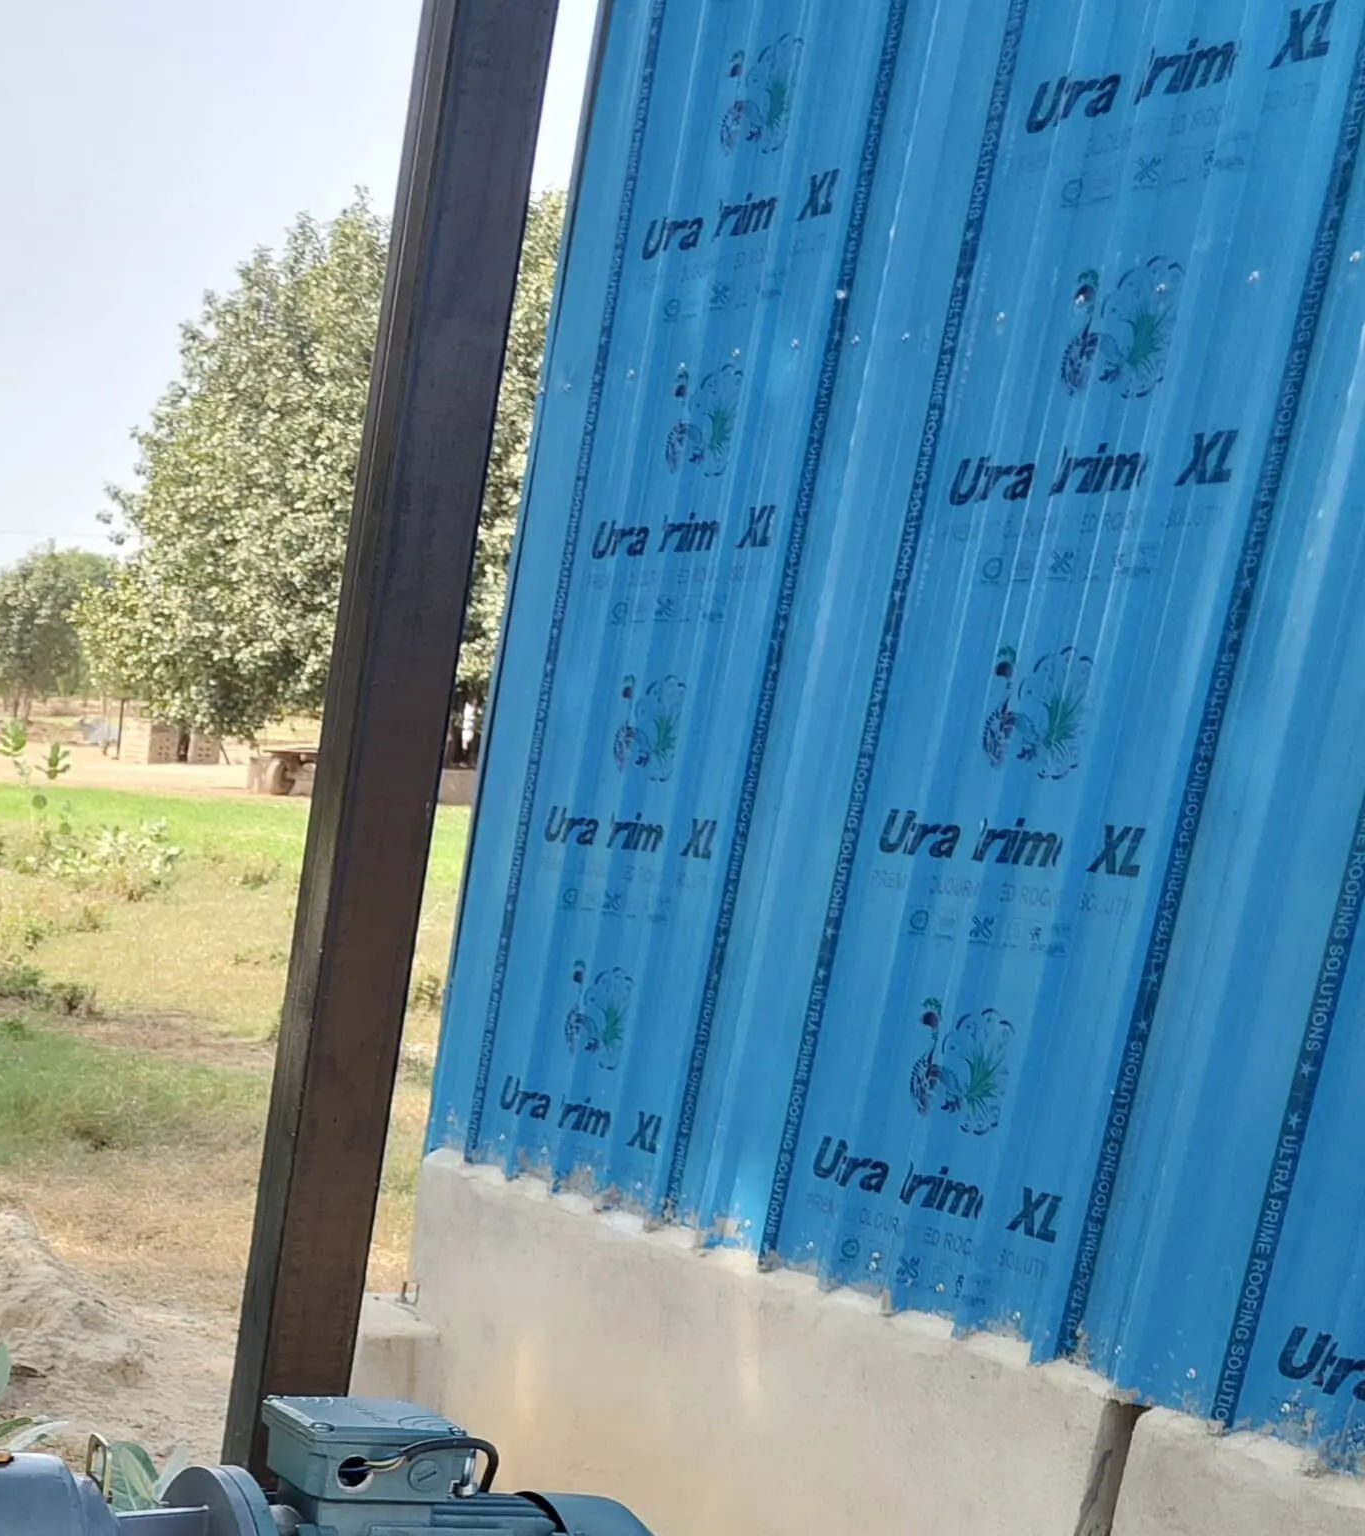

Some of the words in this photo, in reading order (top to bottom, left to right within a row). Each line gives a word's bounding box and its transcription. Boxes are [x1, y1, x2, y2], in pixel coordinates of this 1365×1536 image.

[1268, 0, 1336, 69] XL
[796, 168, 839, 221] XL
[1174, 429, 1238, 487] XL
[736, 505, 776, 549] XL
[1150, 905, 1175, 964] ULTRA
[1164, 847, 1189, 904] PRIME
[1198, 650, 1234, 758] SOLUTIONS
[680, 818, 717, 859] XL
[1086, 824, 1146, 878] XL
[1332, 850, 1365, 941] ROOFING
[1304, 943, 1345, 1053] SOLUTIONS
[626, 1111, 661, 1154] XL
[1269, 1133, 1298, 1196] ULTRA
[1006, 1187, 1063, 1244] XL
[1064, 1276, 1089, 1331] ULTRA
[1077, 1221, 1102, 1275] PRIME
[1090, 1140, 1120, 1219] ROOFING
[1255, 1197, 1283, 1256] PRIME
[1233, 1257, 1267, 1341] ROOFING
[1213, 1343, 1246, 1422] SOLUTIO
